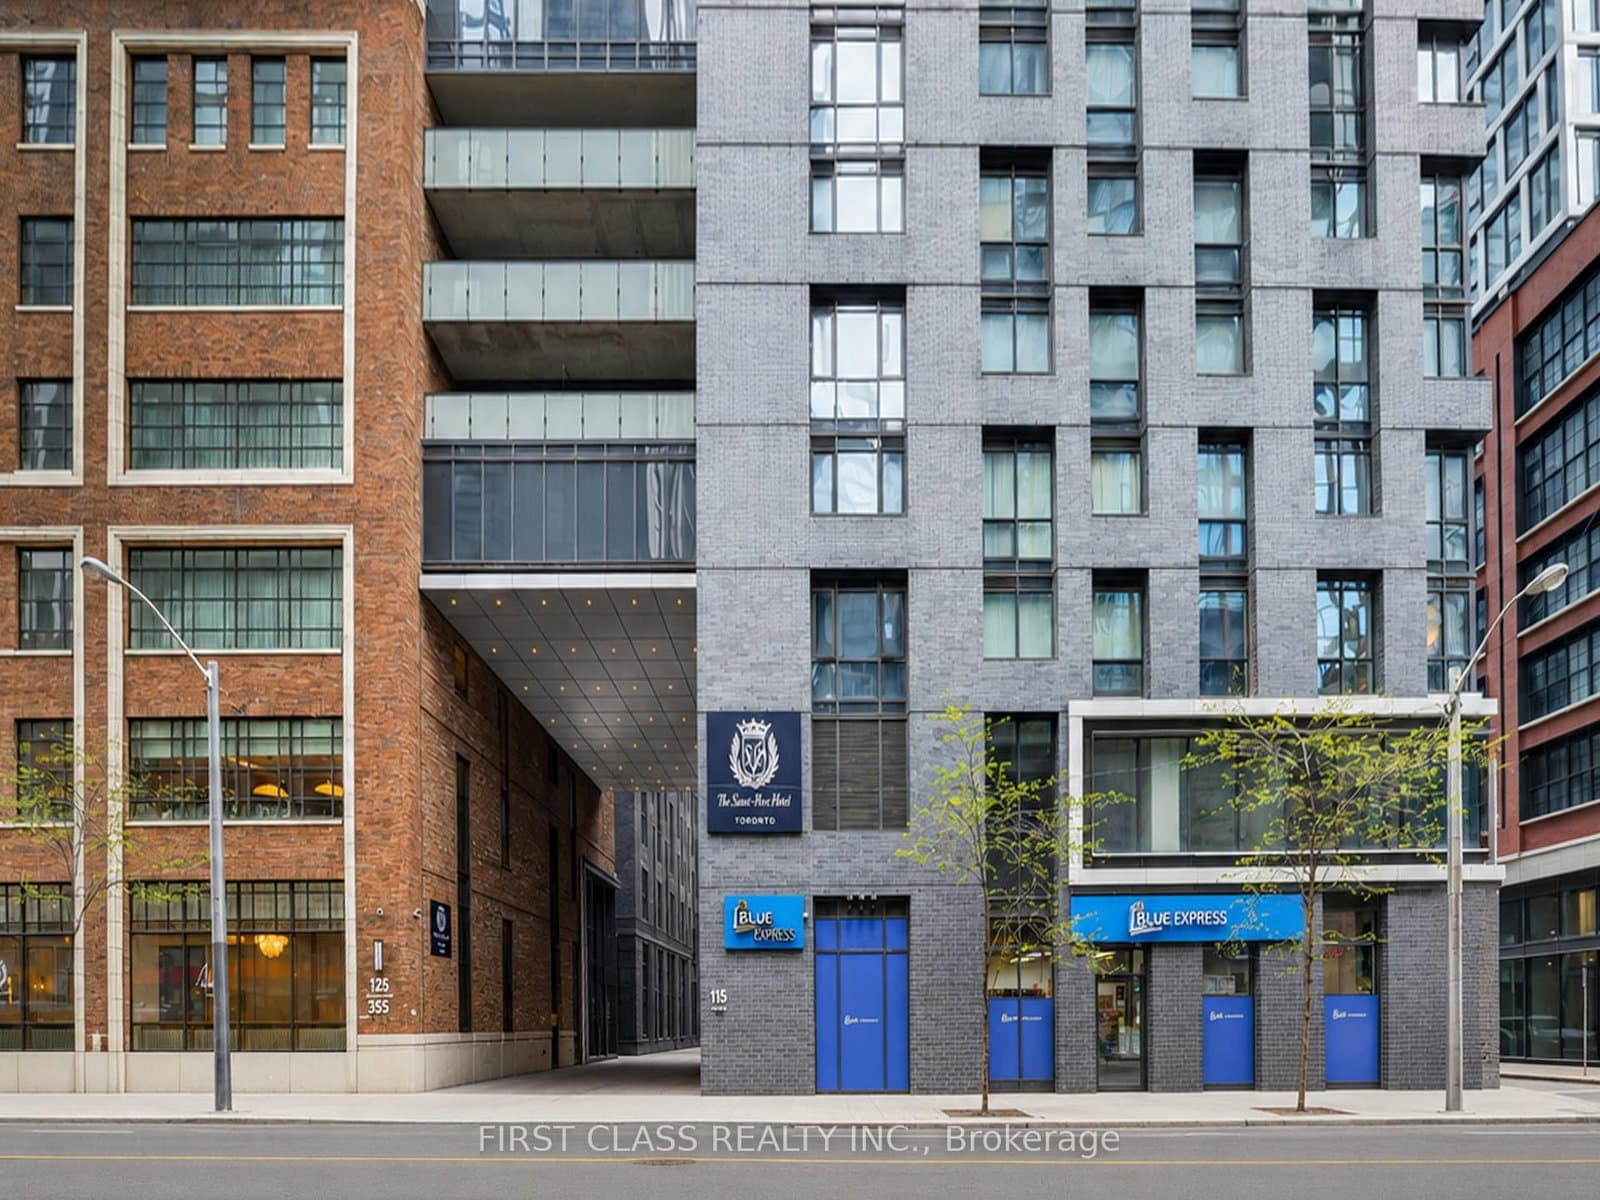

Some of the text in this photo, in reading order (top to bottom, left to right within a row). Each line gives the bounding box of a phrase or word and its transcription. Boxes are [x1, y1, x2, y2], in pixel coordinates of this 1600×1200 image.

[717, 792, 729, 807] The
[735, 816, 776, 825] TORONTO
[739, 911, 773, 925] BLUE
[1136, 910, 1227, 926] BLUE EXPRESS
[753, 927, 796, 942] EXPRESS
[710, 989, 728, 1004] 115
[367, 999, 389, 1014] 355
